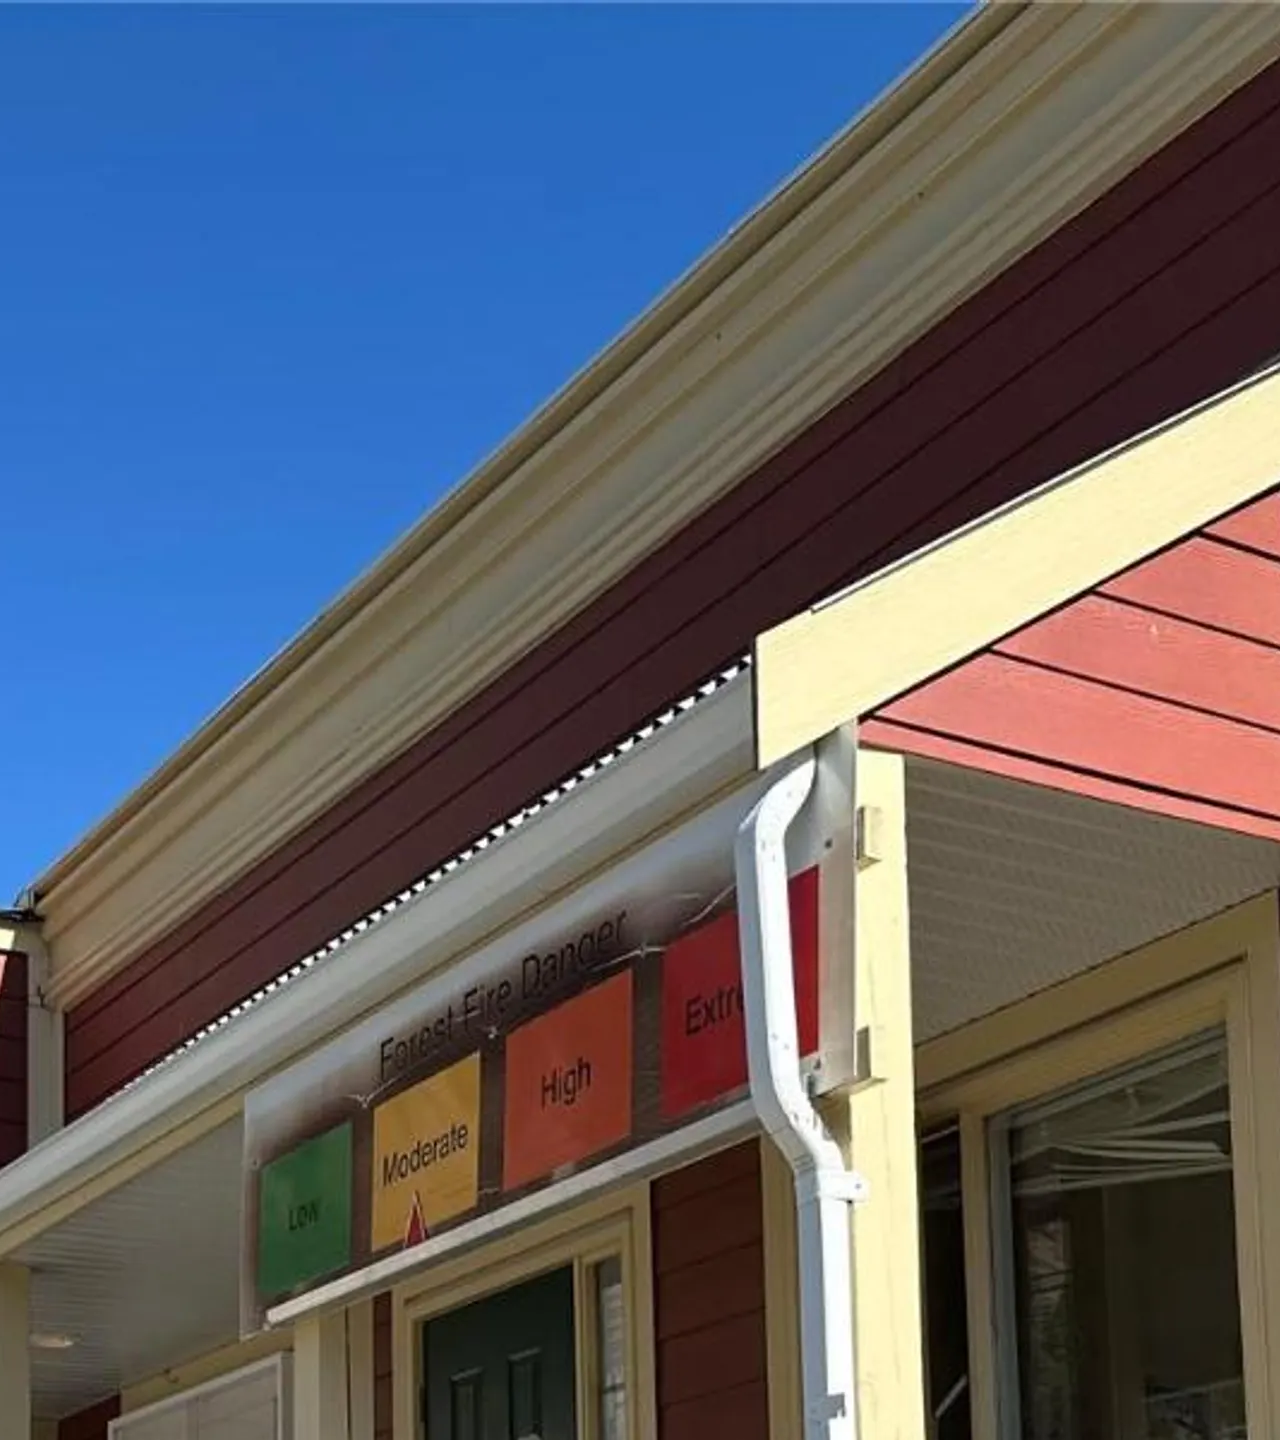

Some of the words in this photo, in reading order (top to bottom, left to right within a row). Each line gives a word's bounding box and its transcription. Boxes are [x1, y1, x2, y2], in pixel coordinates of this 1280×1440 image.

[379, 1004, 454, 1083] Forest
[463, 979, 512, 1031] Fire
[522, 909, 628, 1001] Danger
[541, 1056, 592, 1111] High
[383, 1122, 469, 1187] Moderate
